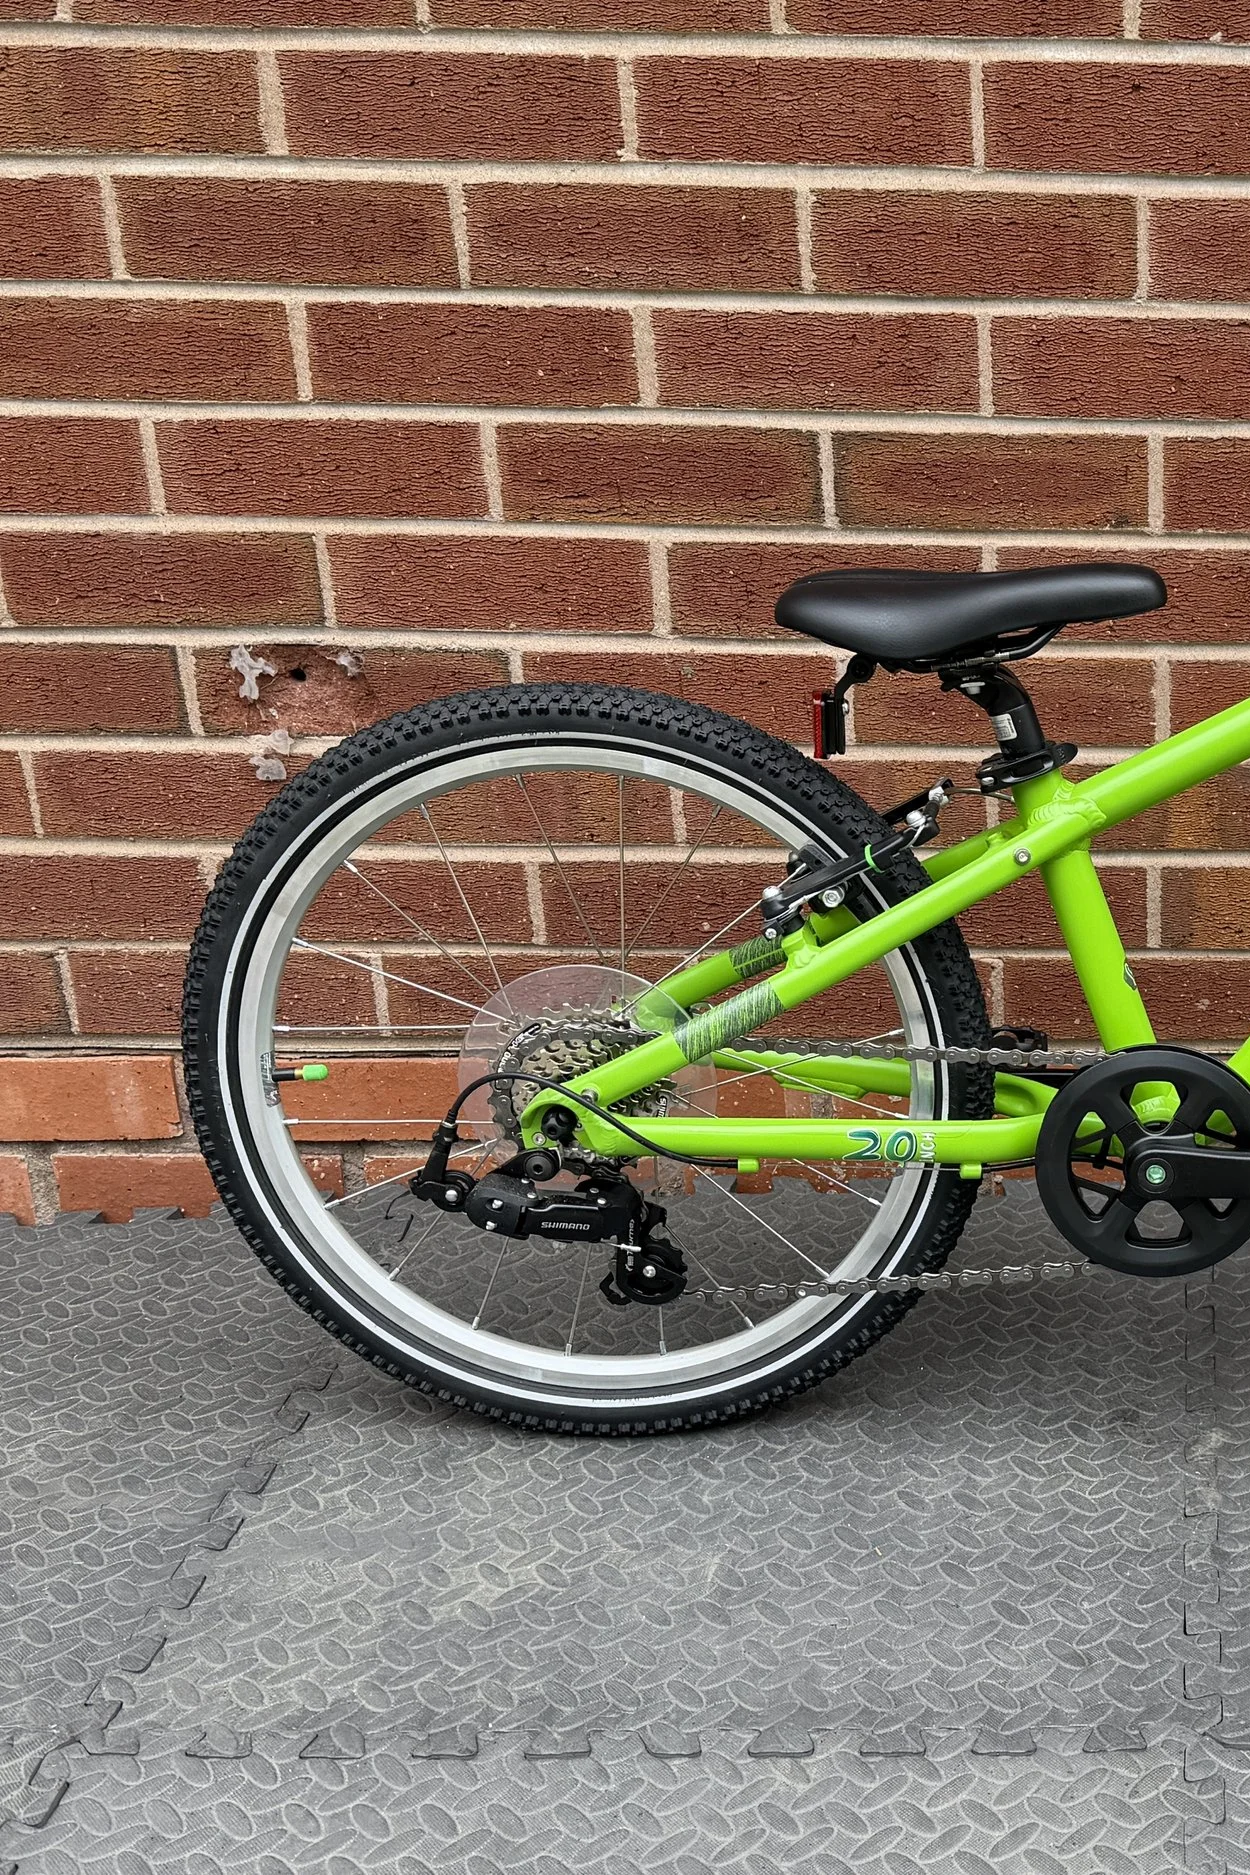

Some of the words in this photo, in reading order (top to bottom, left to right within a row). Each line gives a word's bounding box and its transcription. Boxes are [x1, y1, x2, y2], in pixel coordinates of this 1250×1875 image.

[842, 1128, 918, 1163] 20
[919, 1131, 937, 1163] INCH
[541, 1221, 591, 1231] SHIMANO
